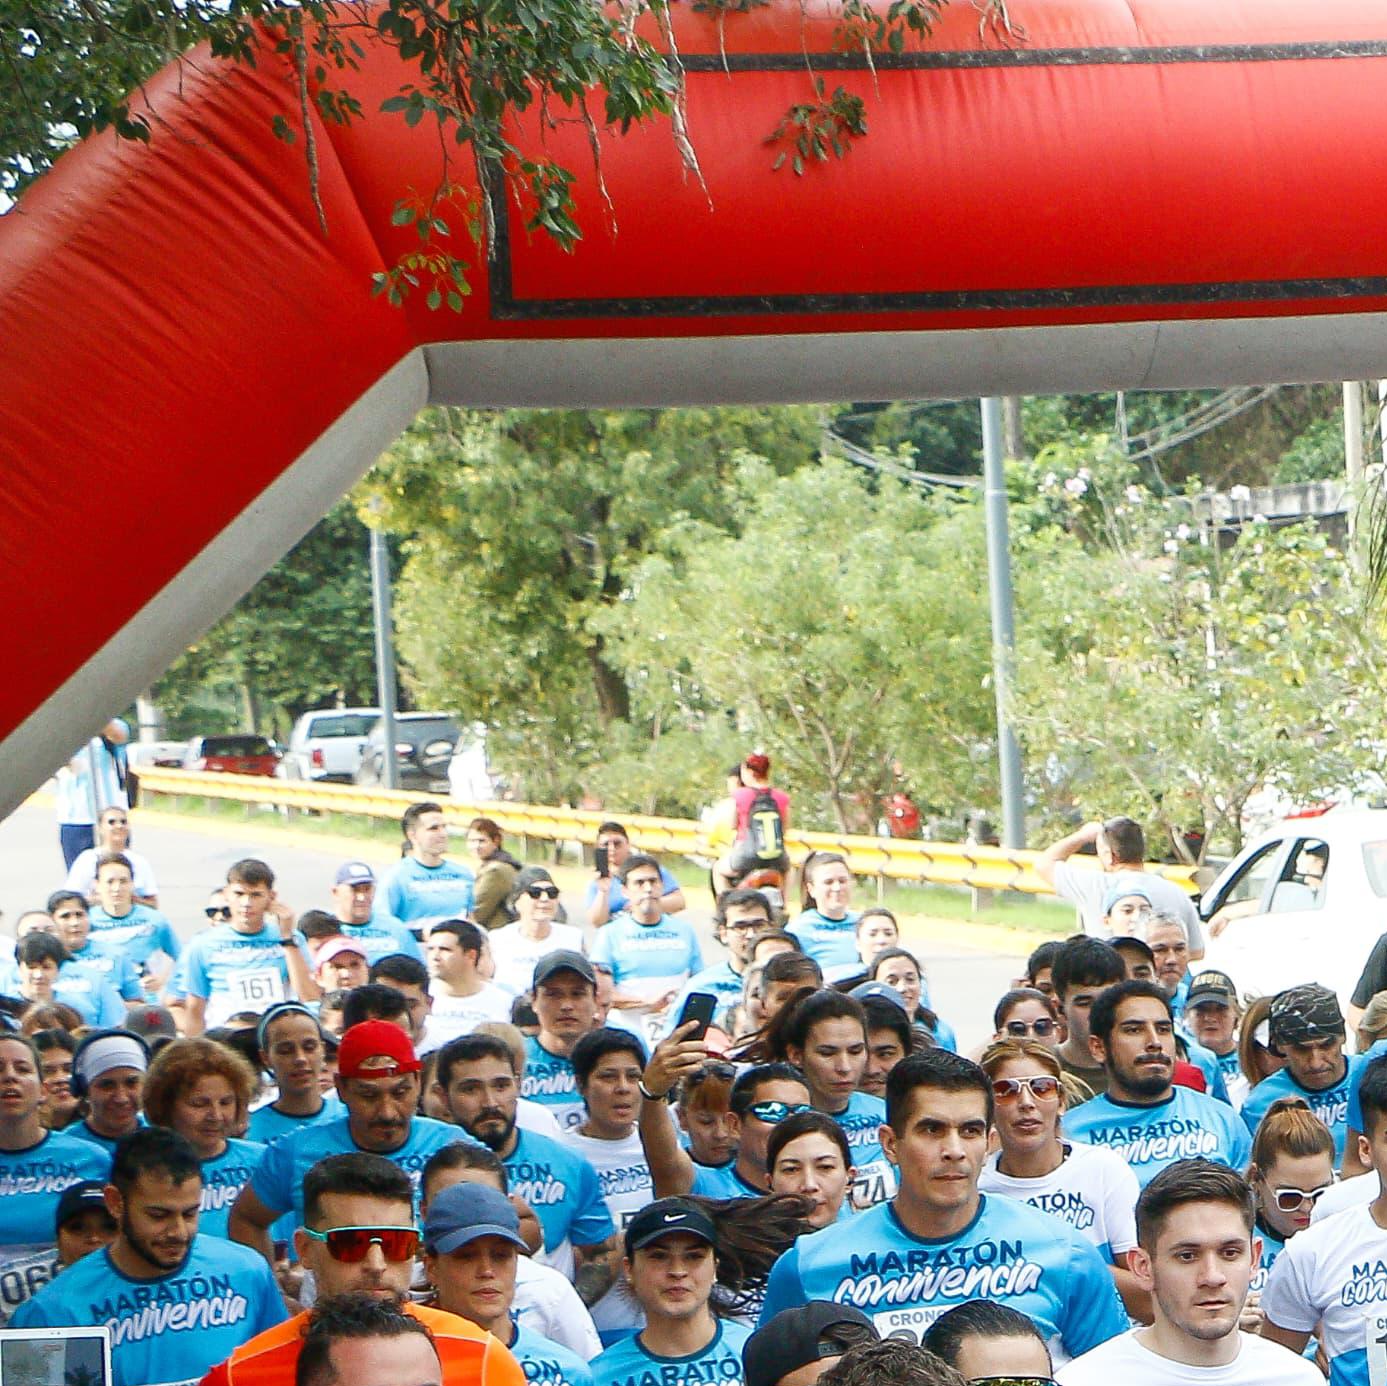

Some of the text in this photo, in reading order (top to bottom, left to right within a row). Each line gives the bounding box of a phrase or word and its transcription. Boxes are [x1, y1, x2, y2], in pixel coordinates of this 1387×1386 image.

[239, 977, 276, 1002] 161
[851, 1239, 1023, 1277] MARATÓN
[90, 1270, 232, 1322] MARATÓN
